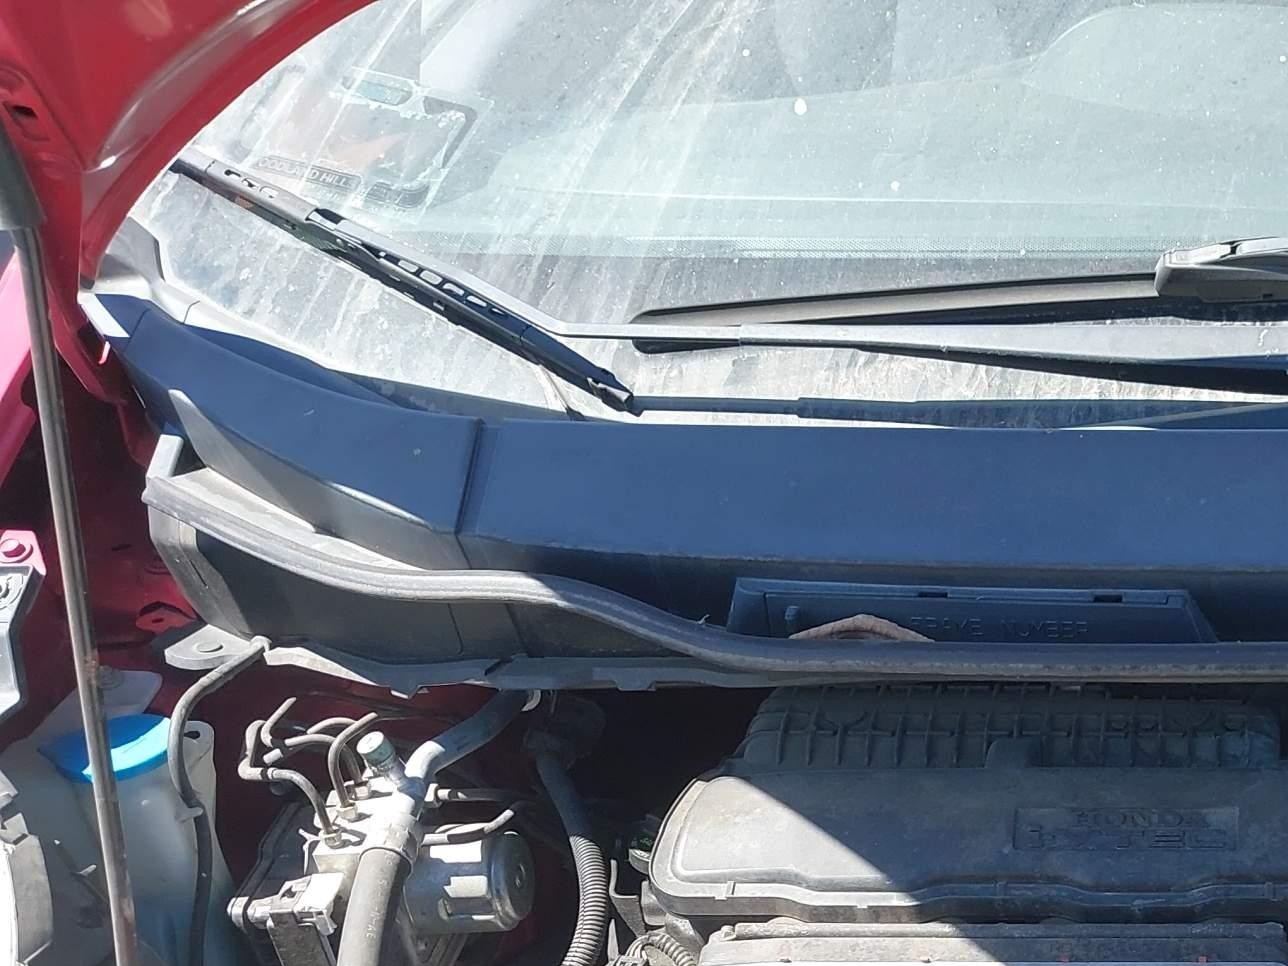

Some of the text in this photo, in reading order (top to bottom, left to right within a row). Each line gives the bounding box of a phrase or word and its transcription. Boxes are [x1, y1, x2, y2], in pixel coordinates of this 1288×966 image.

[911, 616, 1088, 638] FRAME NUMBER
[1076, 810, 1210, 829] HONDA
